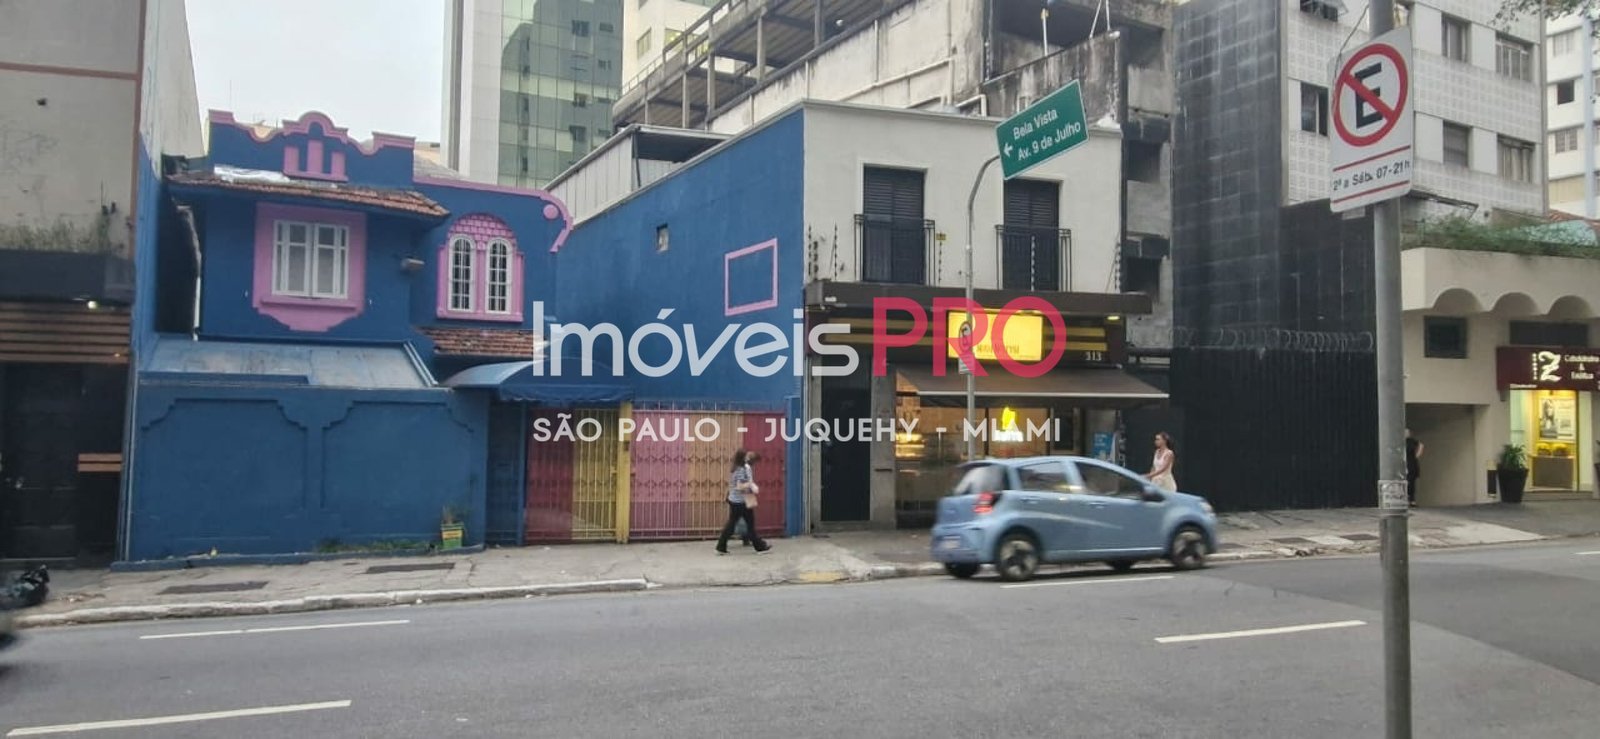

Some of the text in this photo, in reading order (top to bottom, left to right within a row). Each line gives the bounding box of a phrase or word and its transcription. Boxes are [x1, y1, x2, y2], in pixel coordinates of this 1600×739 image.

[1013, 109, 1058, 140] Bela Vista
[1018, 121, 1081, 160] Av. 9 de Julho
